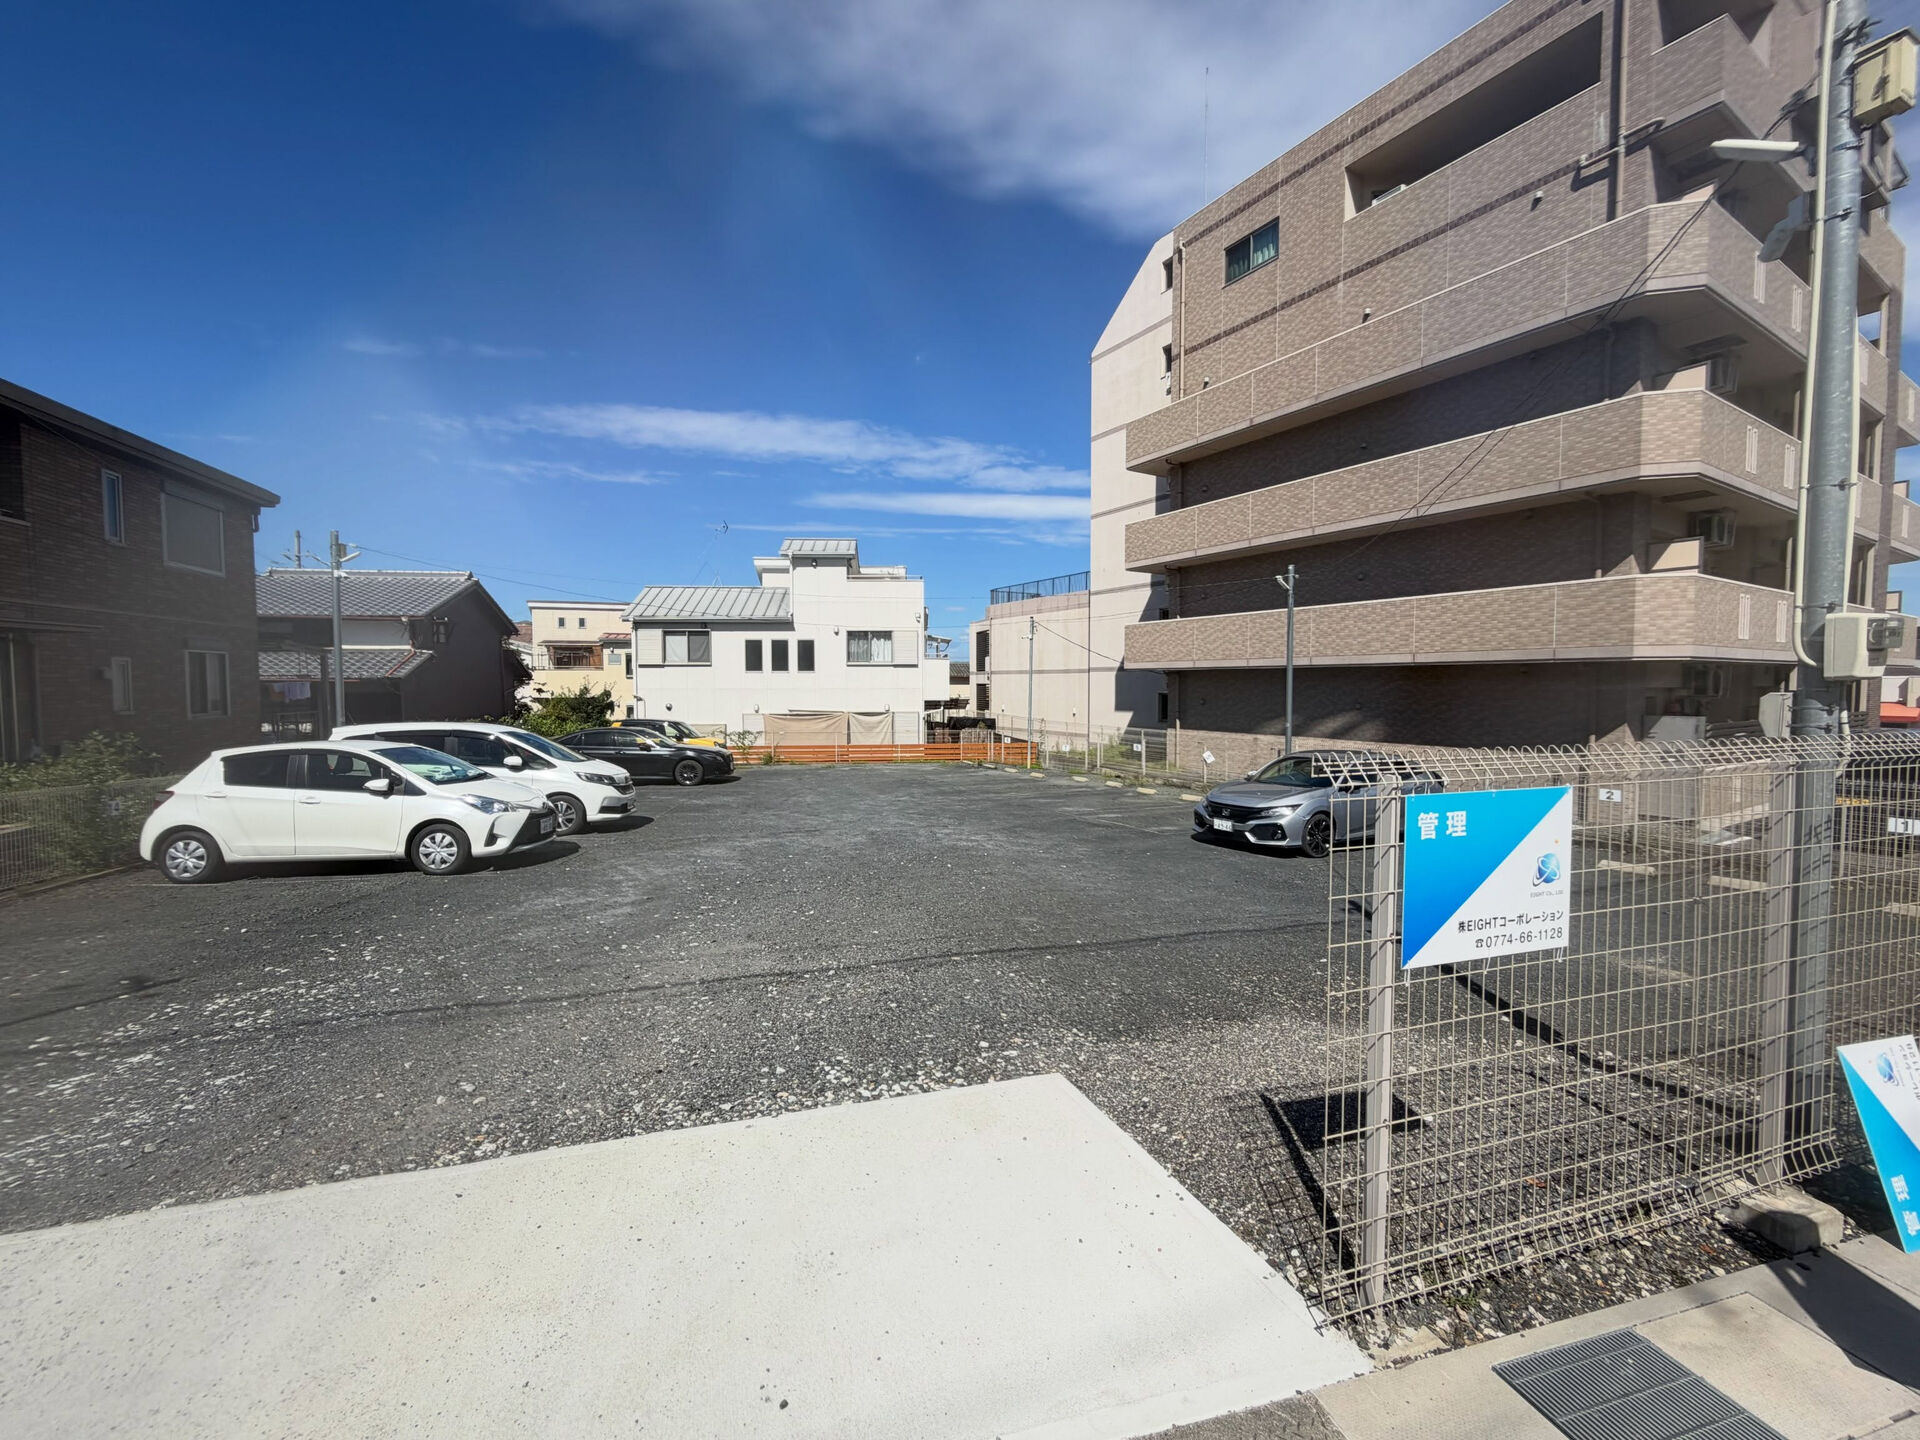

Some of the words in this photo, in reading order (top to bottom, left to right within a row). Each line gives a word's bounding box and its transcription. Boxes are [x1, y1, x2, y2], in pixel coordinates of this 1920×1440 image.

[1605, 790, 1614, 801] 2
[1417, 810, 1468, 841] 管理
[1458, 910, 1564, 933] 株EIGHTコーポレーション
[1485, 927, 1563, 948] 0774-66-1128
